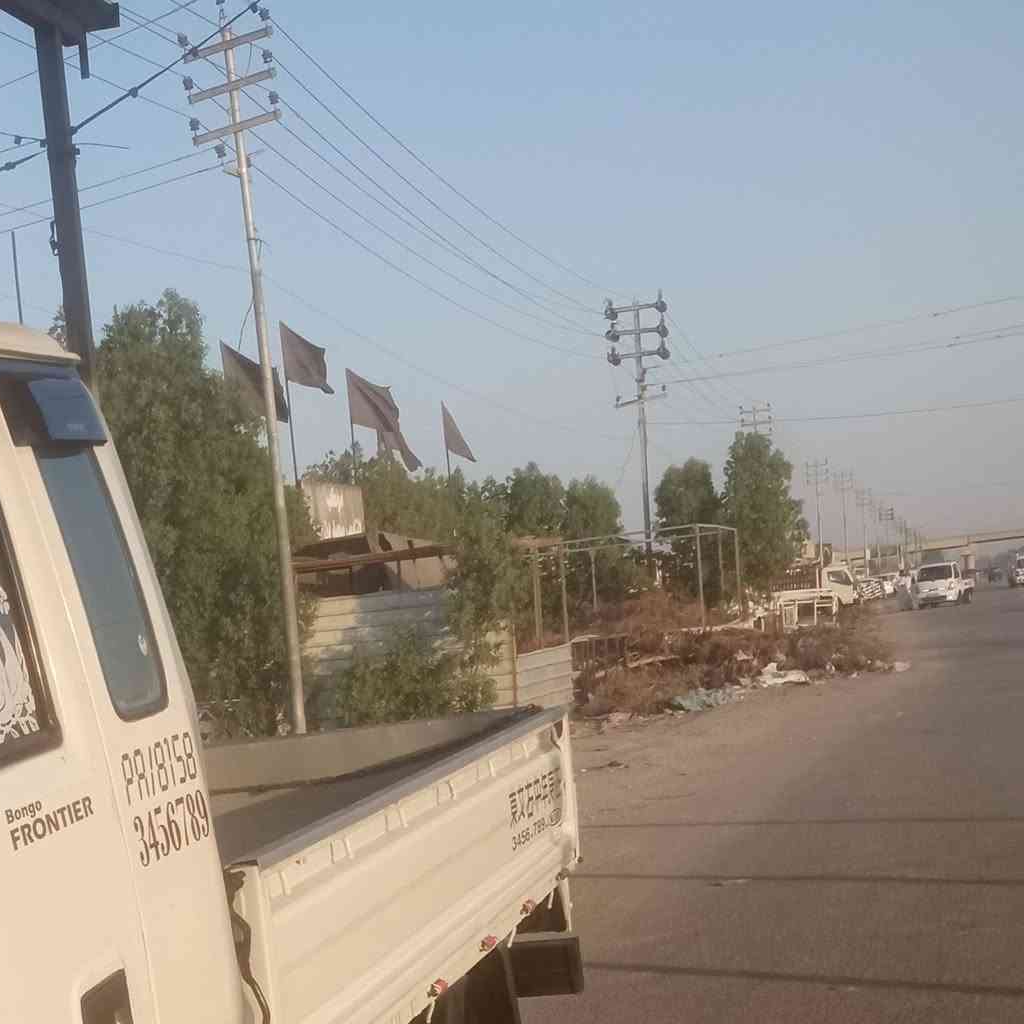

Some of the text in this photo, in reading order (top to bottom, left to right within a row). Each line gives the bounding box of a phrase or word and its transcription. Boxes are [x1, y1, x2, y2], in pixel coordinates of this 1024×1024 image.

[5, 800, 43, 825] Bongo
[9, 795, 95, 851] FRONTIER
[133, 789, 210, 867] 3456789
